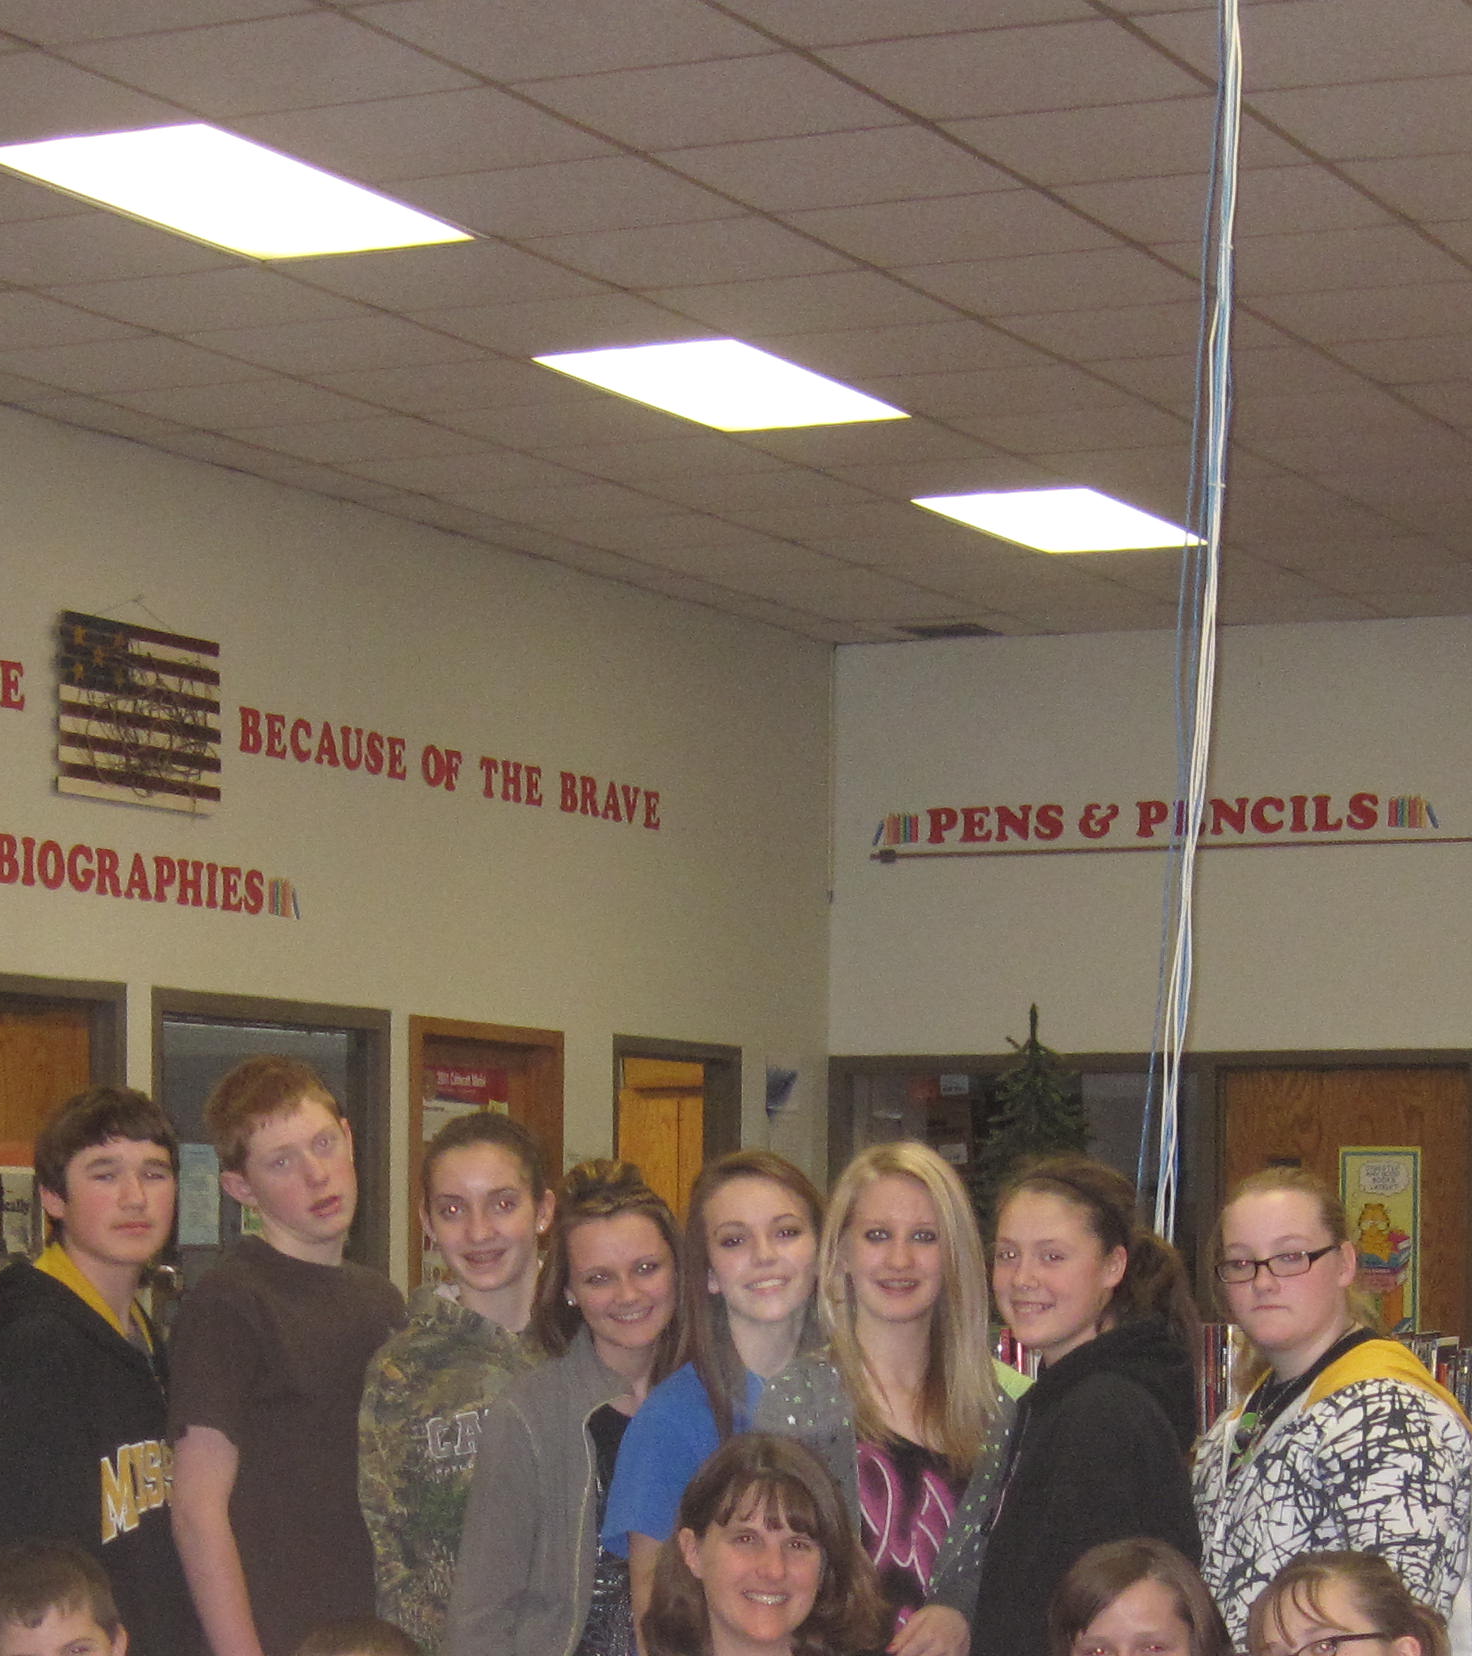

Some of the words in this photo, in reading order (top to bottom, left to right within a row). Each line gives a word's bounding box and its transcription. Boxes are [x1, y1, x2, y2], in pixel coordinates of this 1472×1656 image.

[239, 706, 408, 780] BECAUSE
[421, 744, 463, 791] OF
[479, 756, 543, 806] THE
[559, 771, 661, 830] BRAVE
[928, 804, 1064, 844] PENS
[1078, 802, 1120, 838] &
